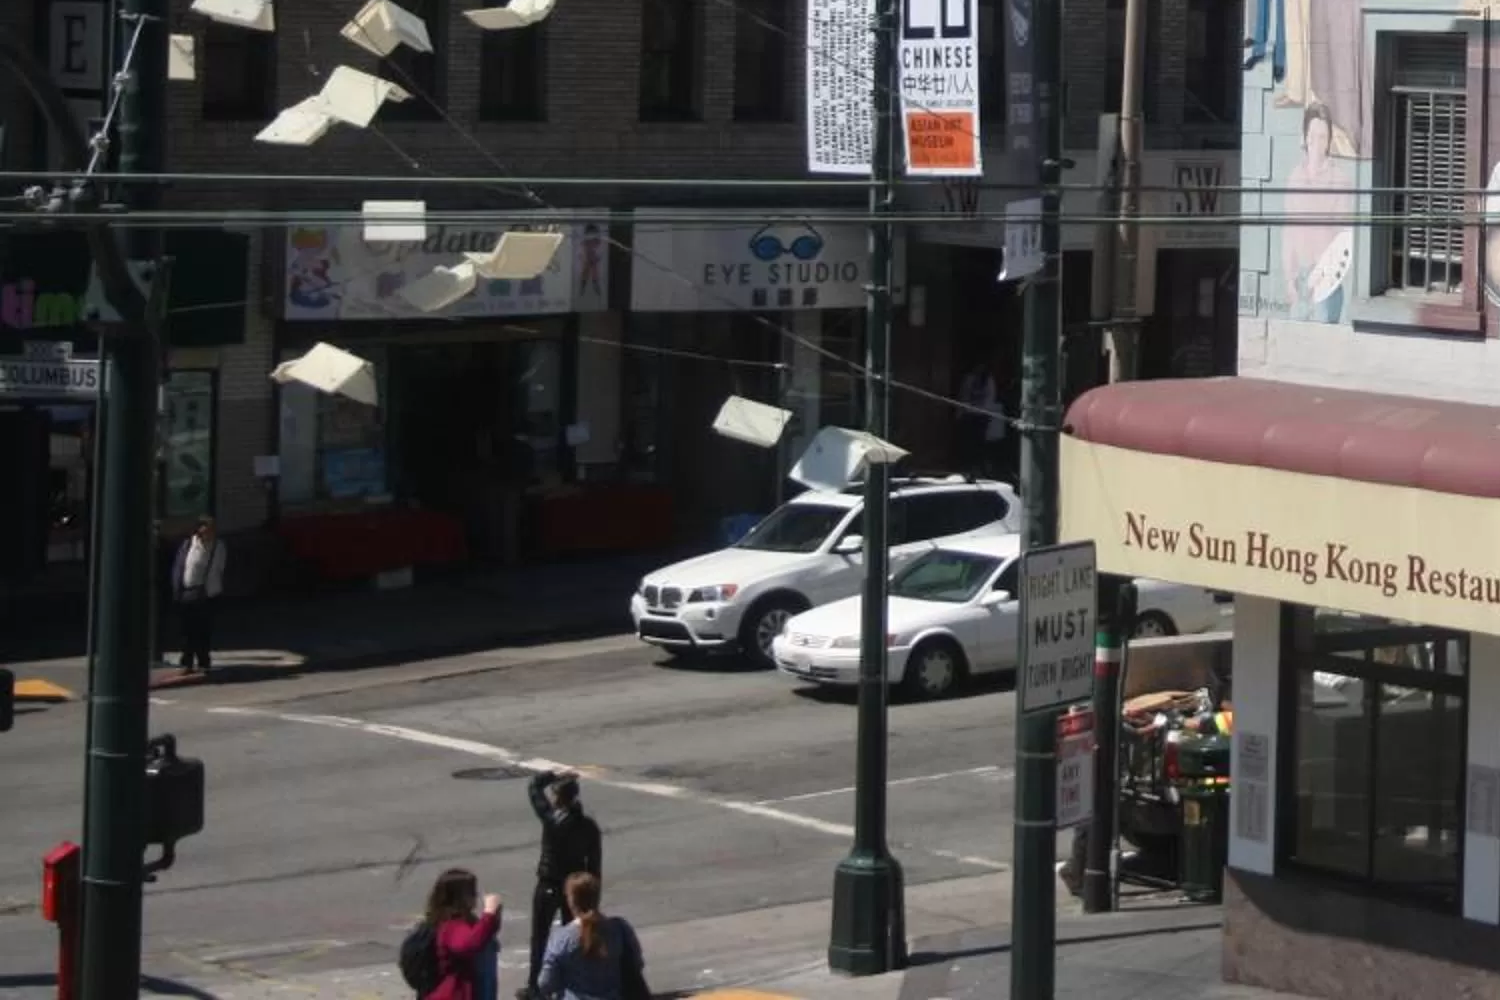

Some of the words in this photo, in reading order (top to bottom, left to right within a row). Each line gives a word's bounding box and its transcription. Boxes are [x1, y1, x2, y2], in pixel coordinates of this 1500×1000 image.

[902, 45, 973, 69] CHINESE
[704, 263, 751, 285] EYE
[768, 262, 859, 284] STUDIO
[1124, 511, 1181, 555] New
[1187, 522, 1237, 565] Sun
[1245, 531, 1318, 584] Hong
[1324, 542, 1398, 597] Kong
[1029, 570, 1061, 601] RIGHT
[1063, 566, 1093, 595] LANE
[1035, 609, 1088, 647] MUST
[1028, 663, 1057, 690] TURN
[1060, 654, 1093, 684] RIGHT
